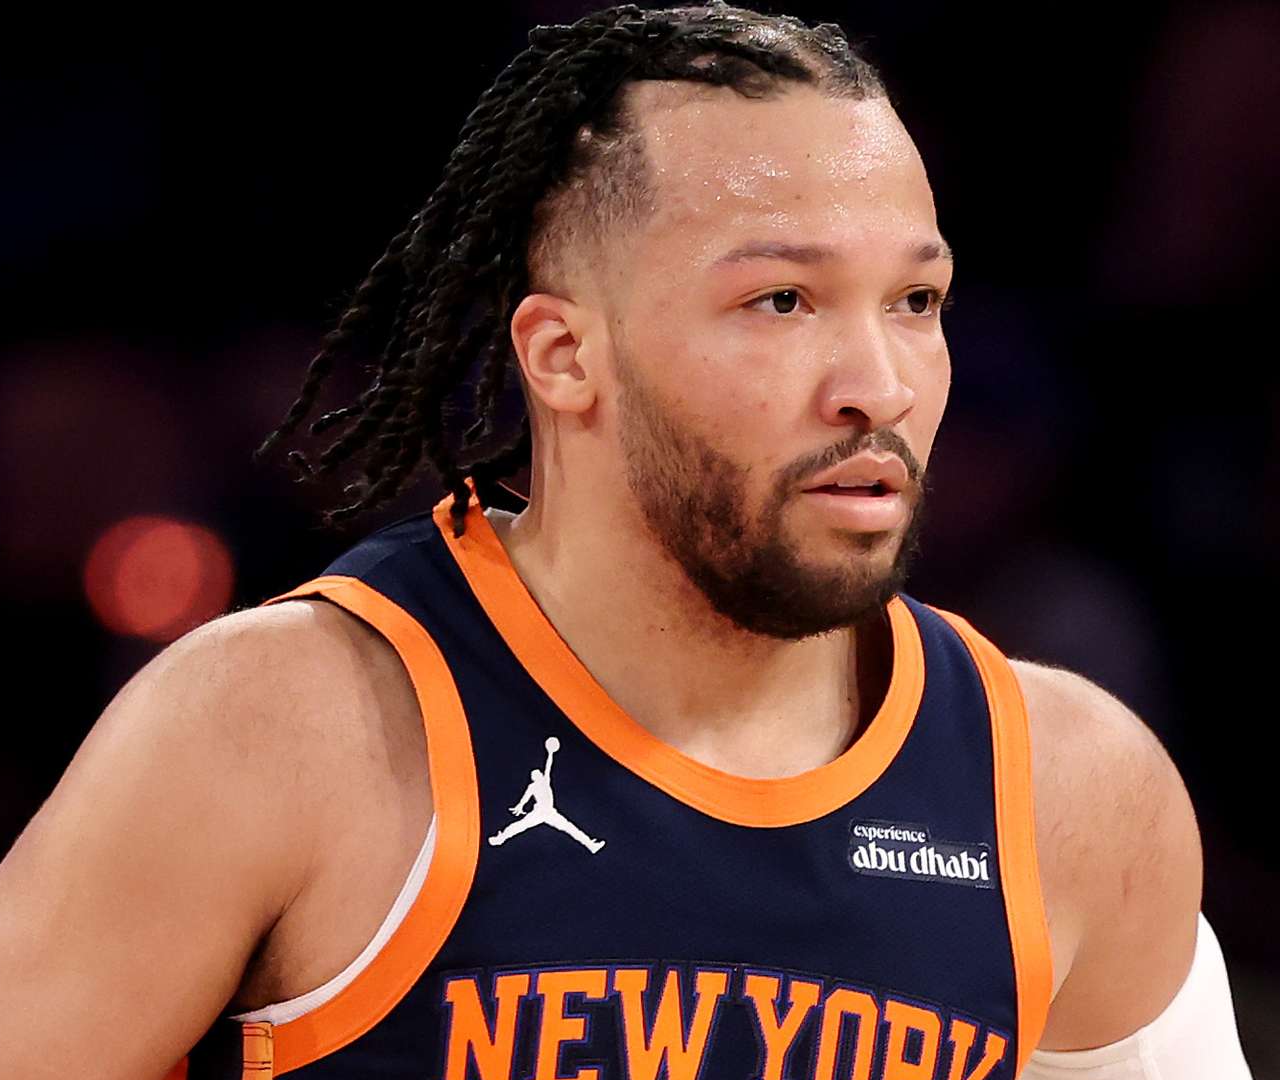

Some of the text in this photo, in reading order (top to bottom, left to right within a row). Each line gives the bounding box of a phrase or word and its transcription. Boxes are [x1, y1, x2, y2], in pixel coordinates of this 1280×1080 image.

[853, 824, 926, 843] experience
[852, 841, 990, 881] abu dhabi
